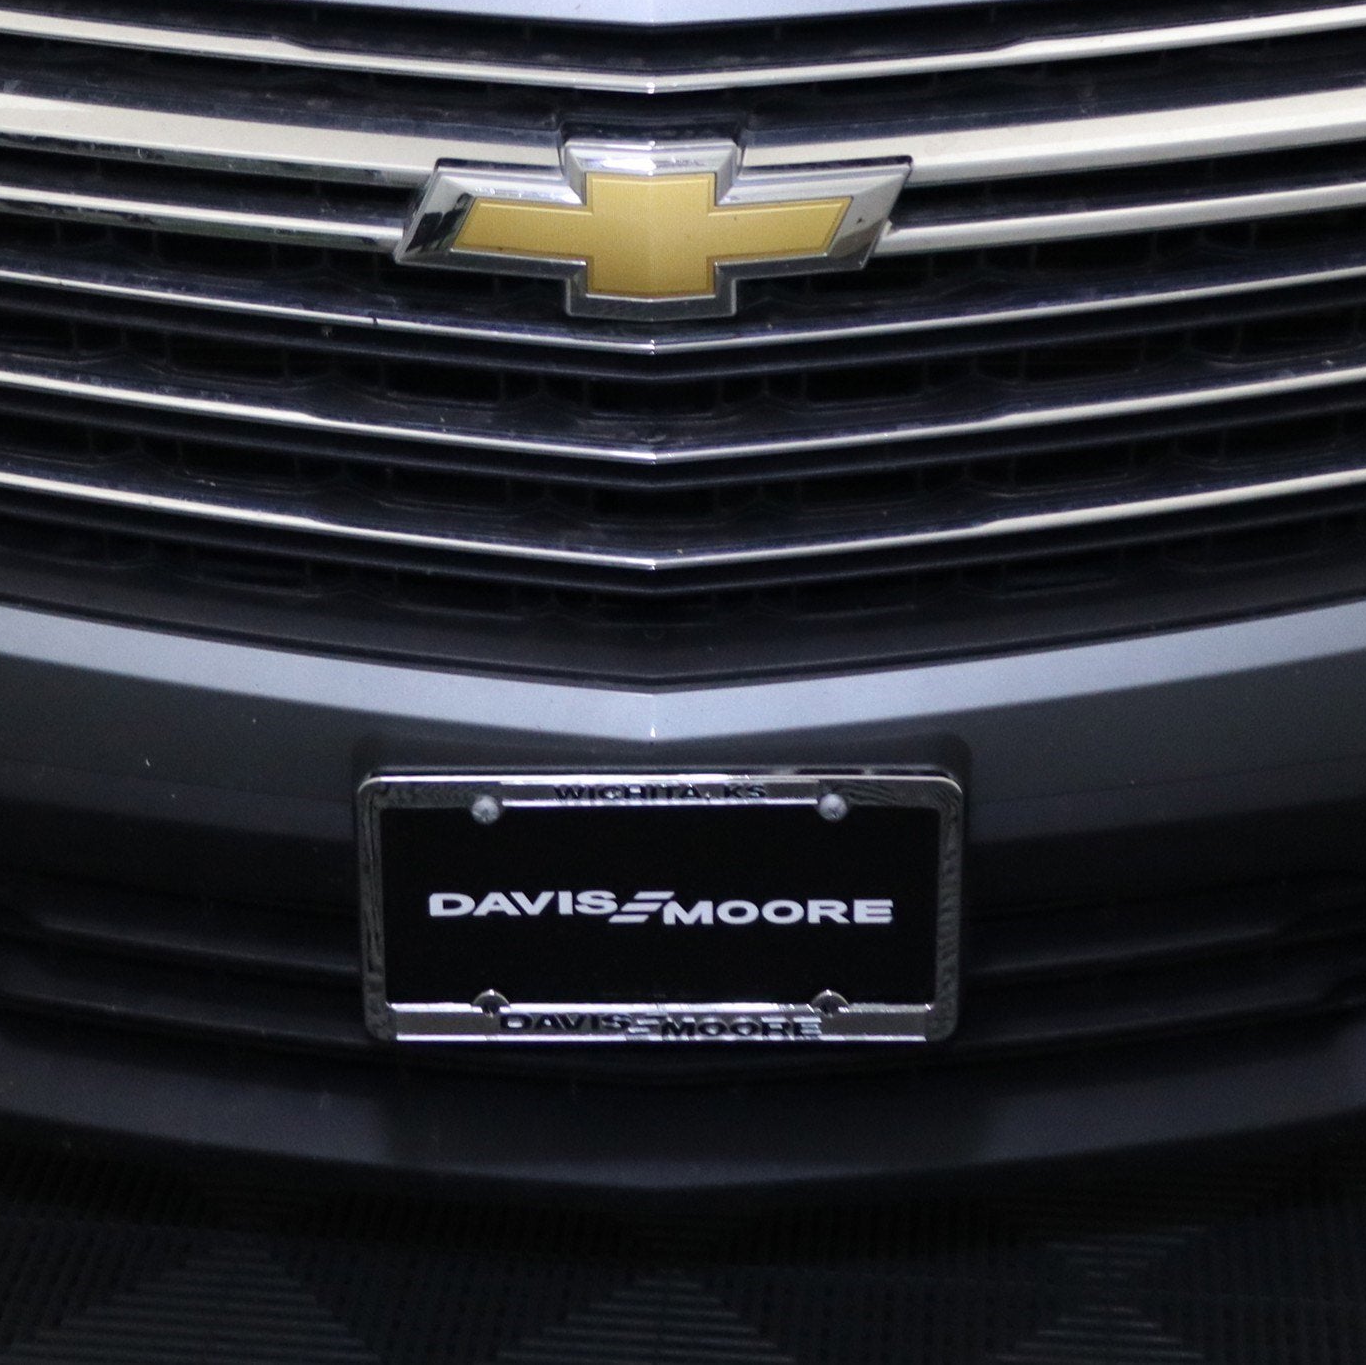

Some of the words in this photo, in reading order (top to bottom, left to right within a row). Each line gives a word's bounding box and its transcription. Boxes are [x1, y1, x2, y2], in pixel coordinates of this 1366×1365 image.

[429, 890, 618, 917] DAVIS
[663, 899, 895, 925] MOORE
[500, 1012, 632, 1030] DAVIS
[661, 1016, 823, 1038] MOORE
